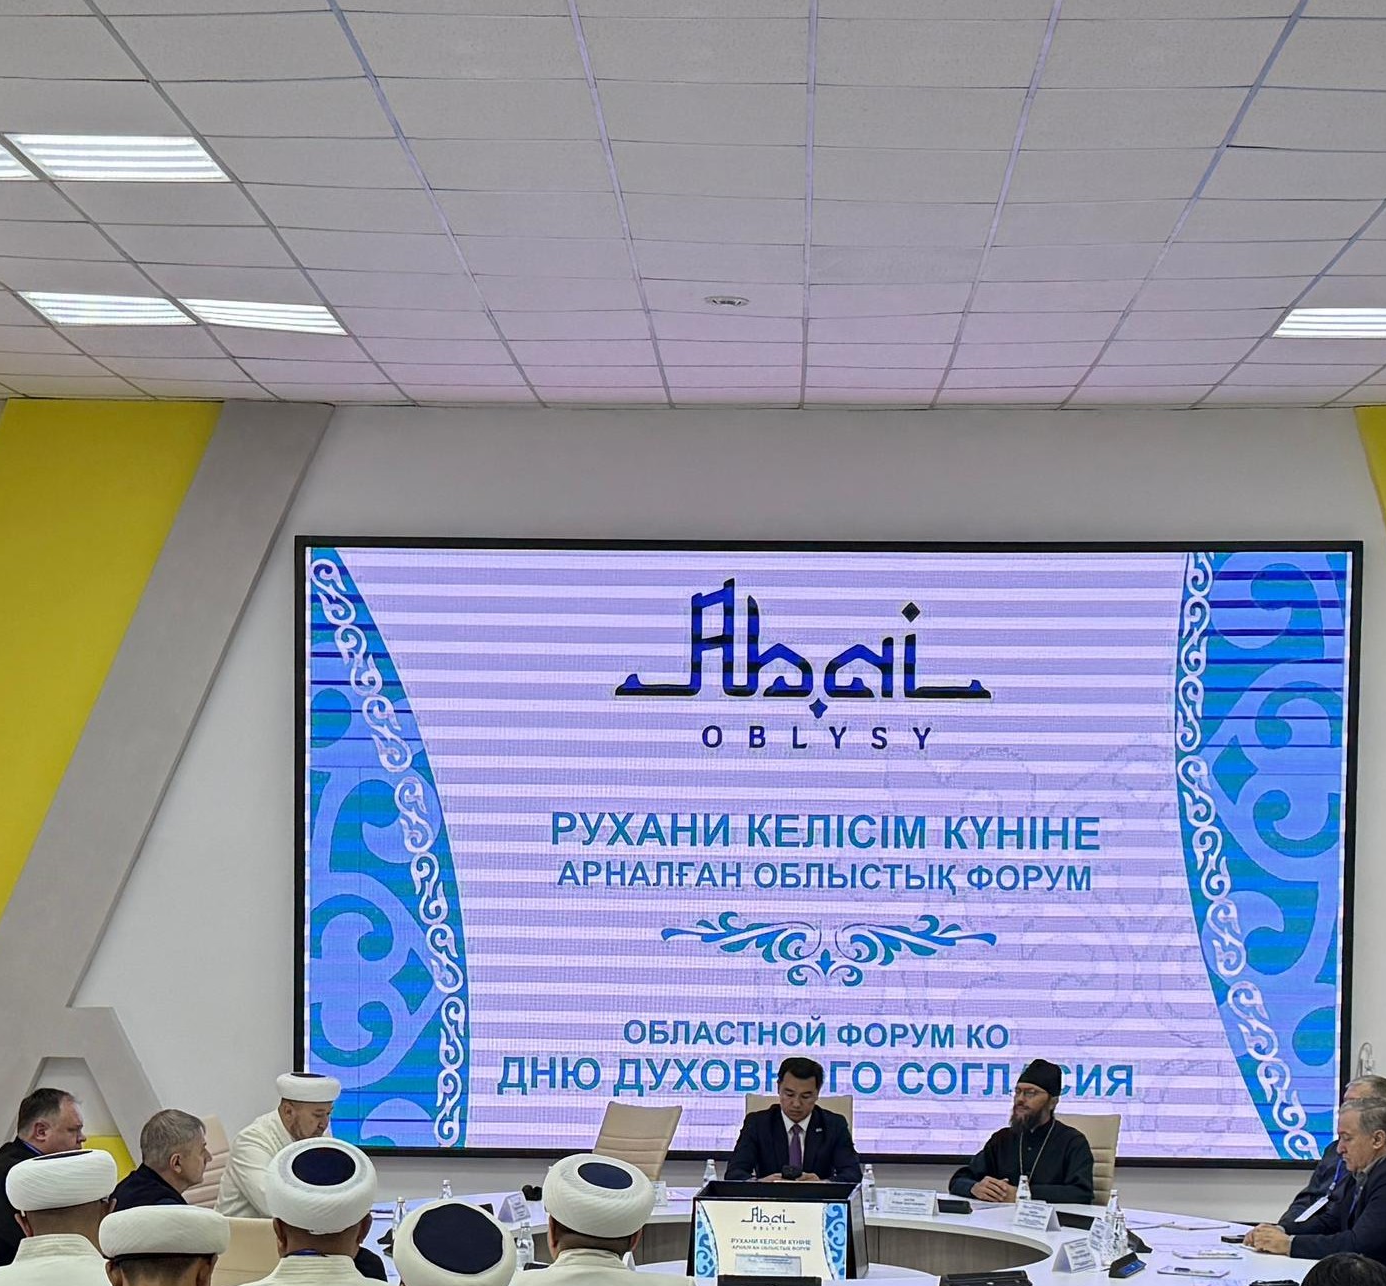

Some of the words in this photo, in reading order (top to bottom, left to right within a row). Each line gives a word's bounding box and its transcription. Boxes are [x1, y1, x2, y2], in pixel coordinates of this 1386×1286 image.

[615, 577, 992, 719] Abai
[701, 724, 932, 750] OBLYSY
[551, 811, 730, 848] РУХАНИ
[747, 813, 926, 849] КЕЛІСІМ
[944, 816, 1101, 851] КҮНІНЕ
[557, 860, 742, 889] АРНАЛҒАН
[753, 861, 957, 896] ОБЛЫСТЫҚ
[966, 864, 1092, 891] ФОРУМ
[623, 1014, 826, 1046] ОБЛАСТНОЙ
[837, 1022, 955, 1049] ФОРУМ
[967, 1023, 1010, 1050] КО
[496, 1056, 601, 1096] ДНЮ
[612, 1058, 882, 1098] ДУХОВГО
[897, 1060, 1134, 1097] СОГЛИЯ
